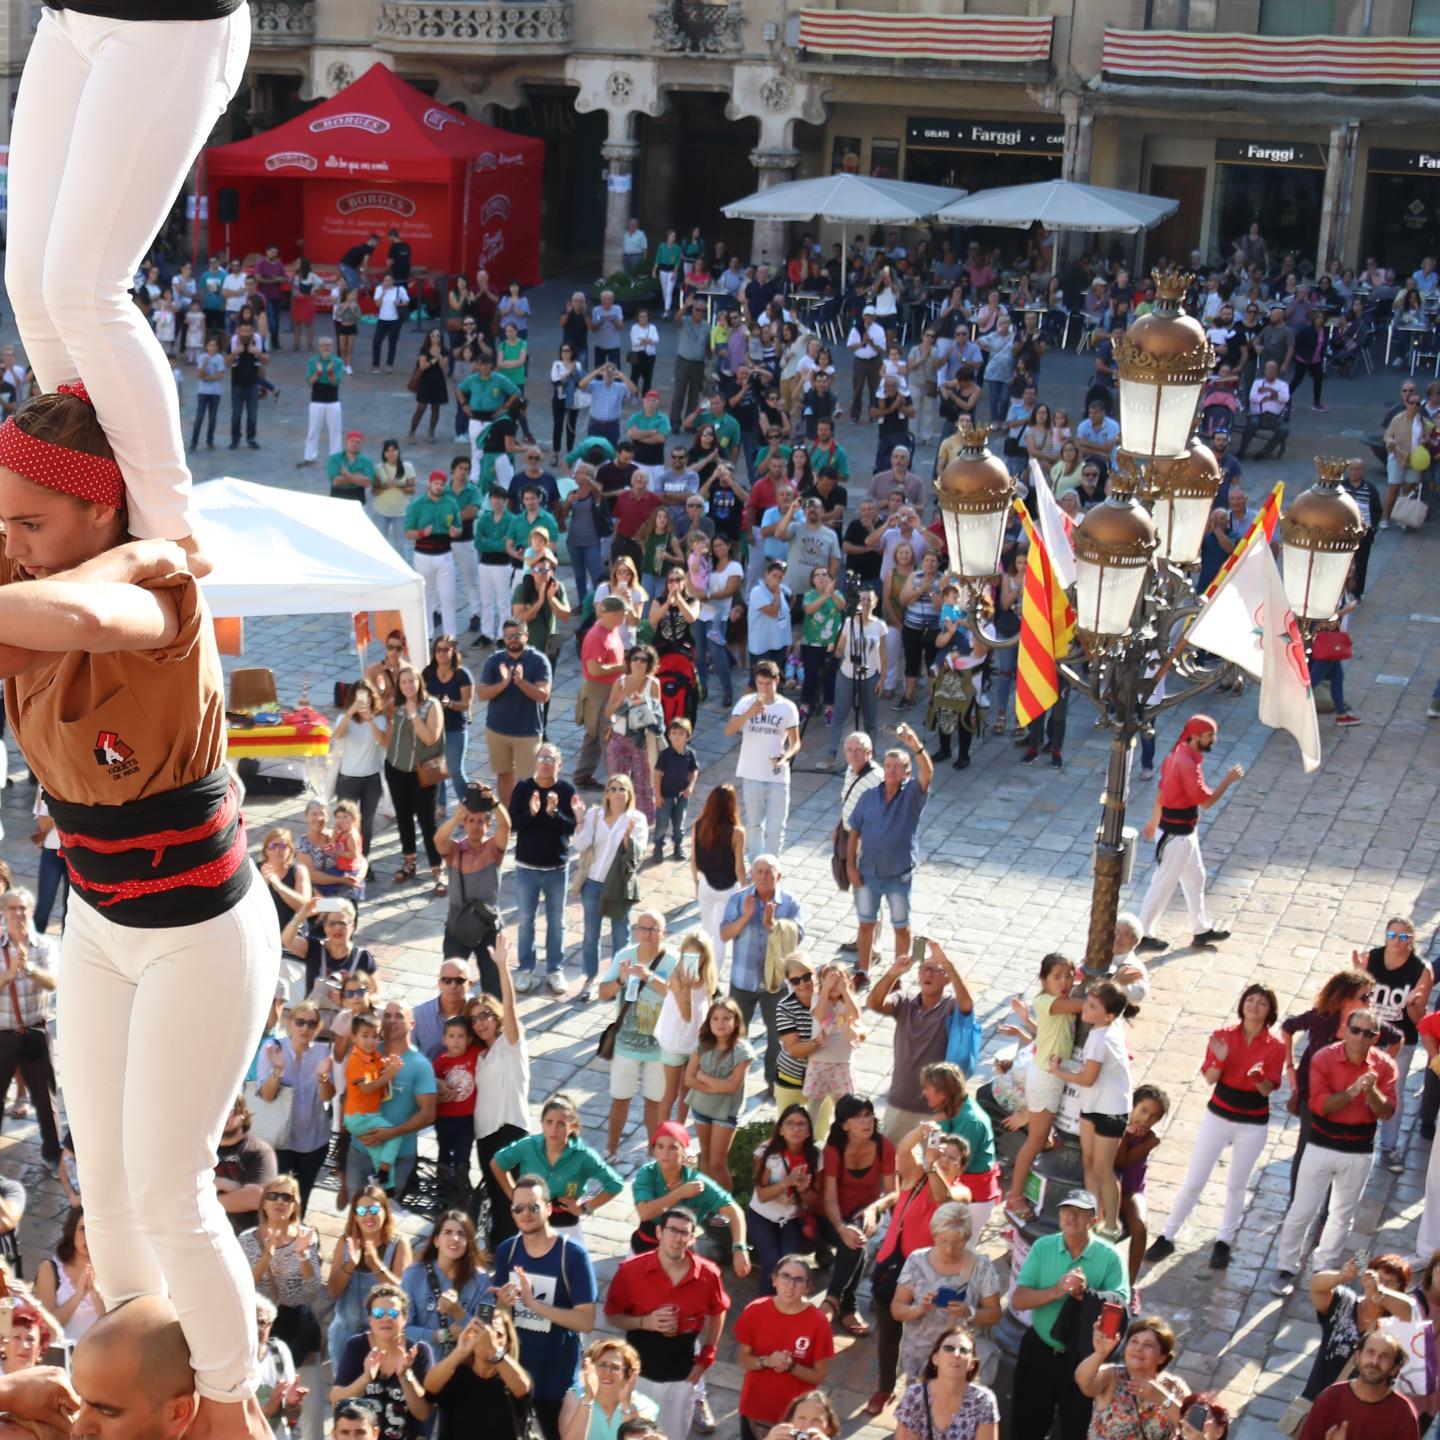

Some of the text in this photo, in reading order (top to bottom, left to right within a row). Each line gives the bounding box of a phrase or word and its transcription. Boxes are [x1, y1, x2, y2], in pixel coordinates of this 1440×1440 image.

[924, 129, 950, 139] GELATS
[971, 127, 1022, 145] Farggi
[1247, 144, 1295, 162] Farggi
[349, 193, 405, 210] BORGES
[107, 759, 138, 775] XIQUETS
